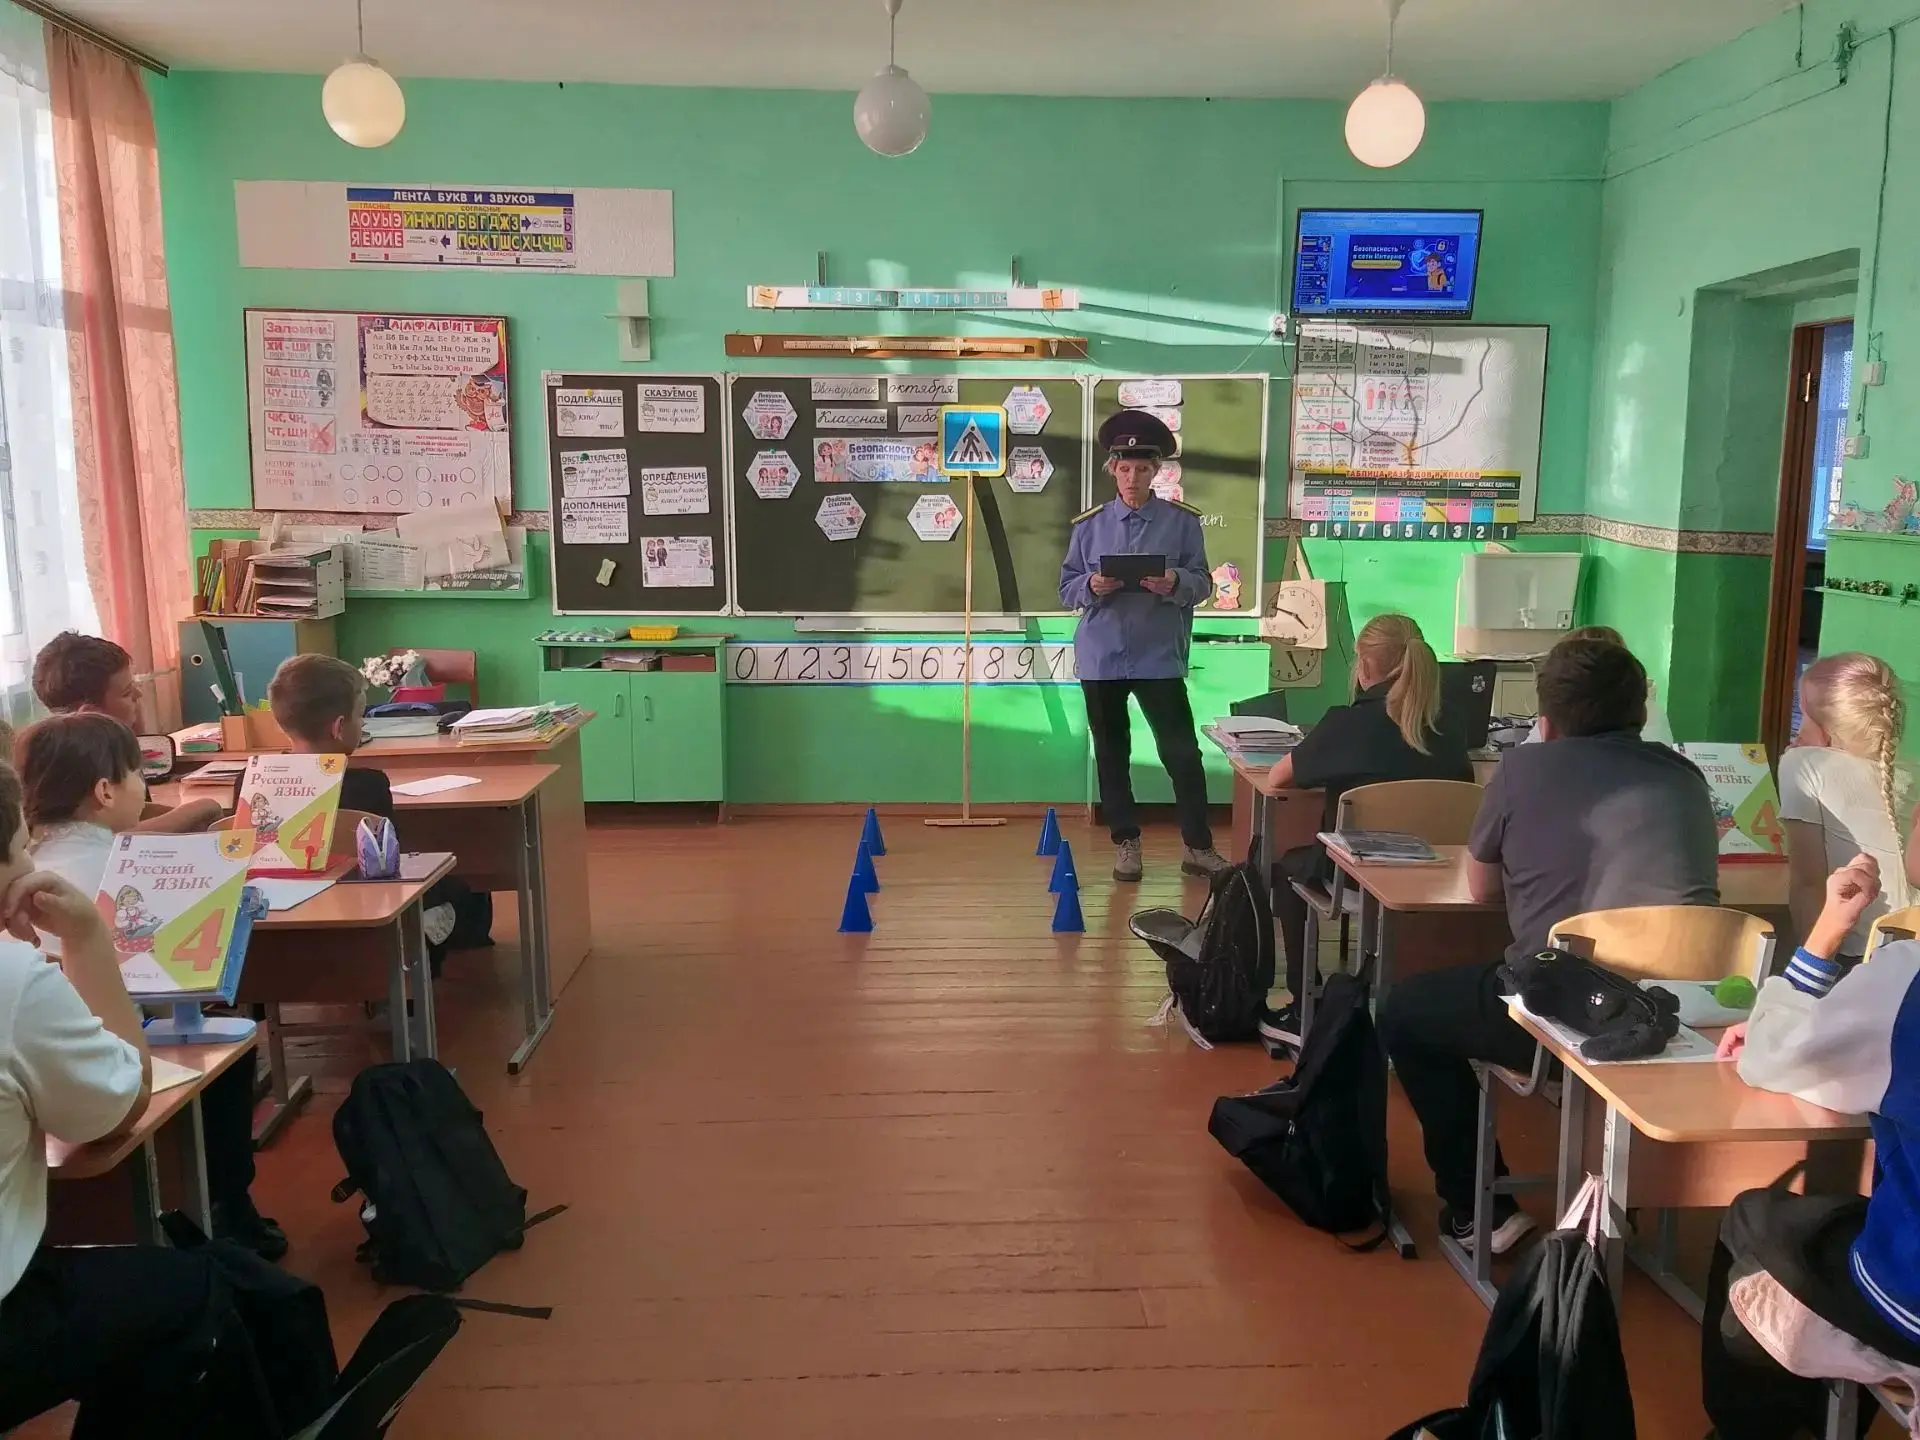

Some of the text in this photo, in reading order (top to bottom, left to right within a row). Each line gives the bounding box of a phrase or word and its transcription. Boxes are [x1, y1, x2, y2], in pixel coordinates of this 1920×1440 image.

[393, 191, 536, 204] ЛЕНТА БУКВ И ЗВУКОВ
[816, 290, 821, 300] 1
[836, 292, 842, 302] 2
[856, 292, 862, 302] 3
[934, 294, 940, 305] 7
[266, 322, 332, 336] Запомни!
[391, 320, 473, 332] АЛФАВИТ
[644, 389, 698, 398] СКАЗУЕМОЕ
[812, 380, 954, 402] Двенадцатое октября
[558, 395, 622, 404] ПОДЛЕЖАЩЕЕ
[818, 408, 937, 431] Классная рабо
[849, 444, 915, 455] Безопасность
[562, 453, 626, 462] ОБСТТЕЛЬСТВО
[876, 454, 910, 463] интернет
[642, 472, 706, 482] ОПРЕДЕЛЕНИЕ
[1388, 470, 1432, 479] РАЗРЯДОВ
[1443, 472, 1480, 480] КЛАССОВ
[563, 502, 626, 511] ДОПОЛНЕНИЕ
[1310, 523, 1508, 539] 9 8 7 6 5 4 3 2 1
[736, 647, 756, 680] 0
[774, 647, 789, 680] 1
[798, 647, 820, 680] 2
[828, 647, 850, 680] 3
[864, 647, 880, 680] 4
[888, 647, 912, 680] 5
[920, 647, 942, 680] 6
[984, 647, 1004, 680] 8
[1014, 647, 1034, 680] 9
[1700, 764, 1736, 773] сский
[250, 773, 304, 786] Русский
[1714, 774, 1752, 784] ЯЗЫК
[274, 786, 316, 797] ЯЗЫК
[1750, 800, 1785, 846] 4
[290, 812, 327, 858] 4
[116, 858, 195, 878] Русский
[152, 876, 213, 890] ЯЗЫК
[170, 908, 226, 971] 4
